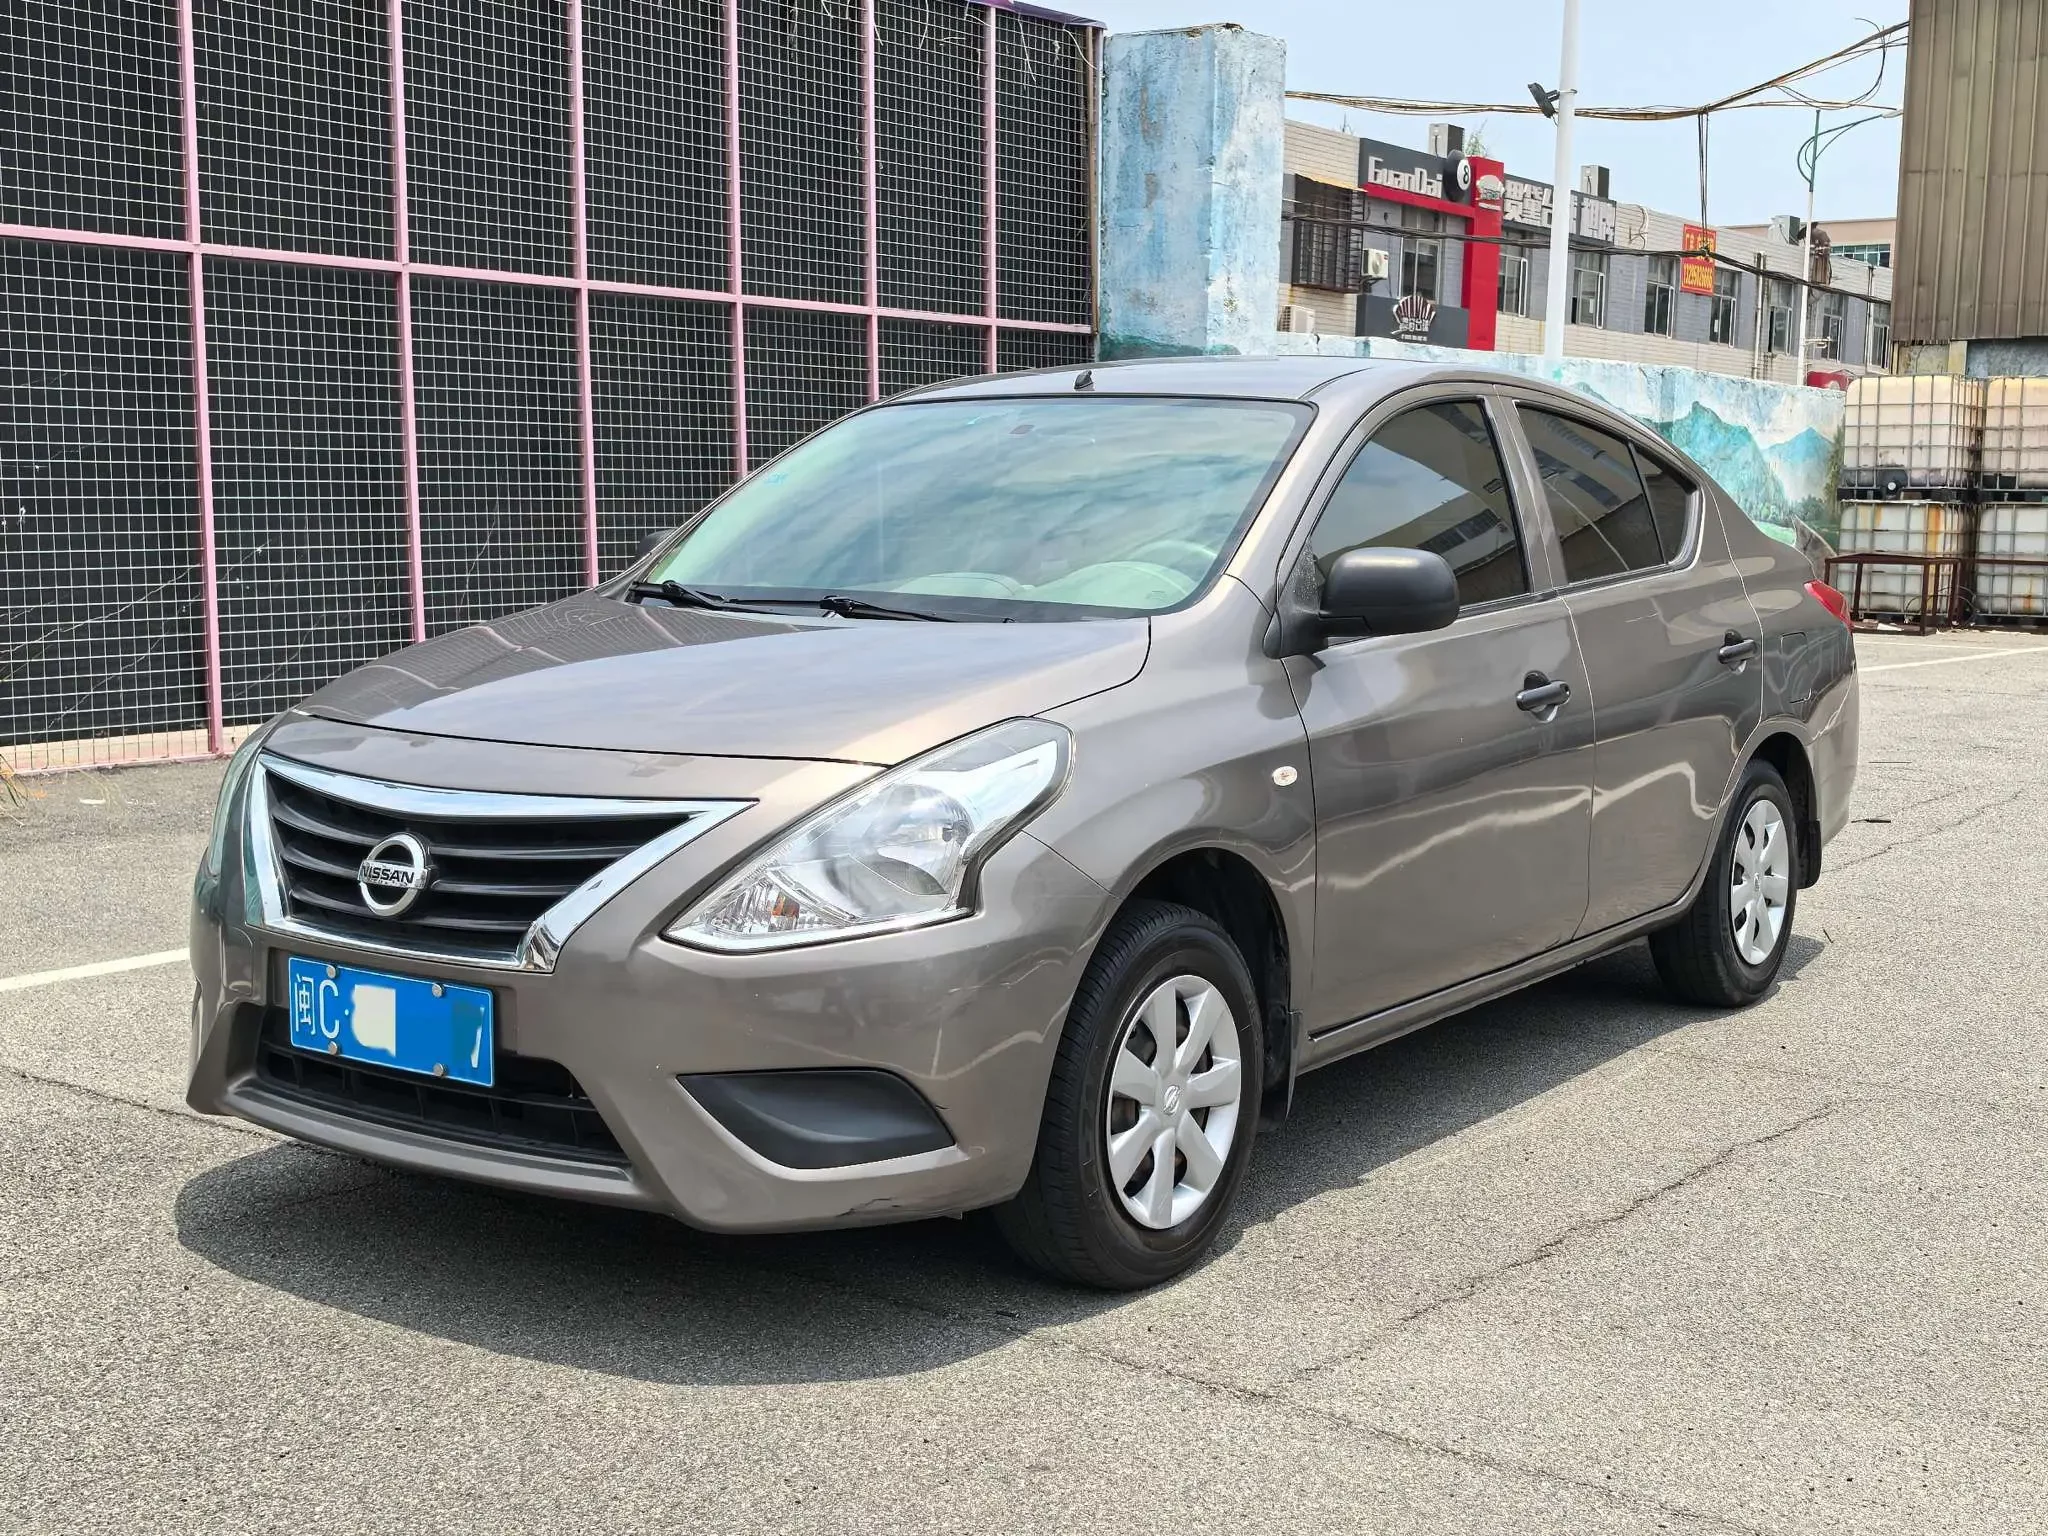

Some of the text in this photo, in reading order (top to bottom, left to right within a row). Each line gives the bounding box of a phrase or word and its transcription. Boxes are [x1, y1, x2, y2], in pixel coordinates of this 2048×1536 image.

[1368, 156, 1443, 199] GuanDai
[1462, 164, 1470, 185] 8
[362, 865, 415, 884] NISSAN
